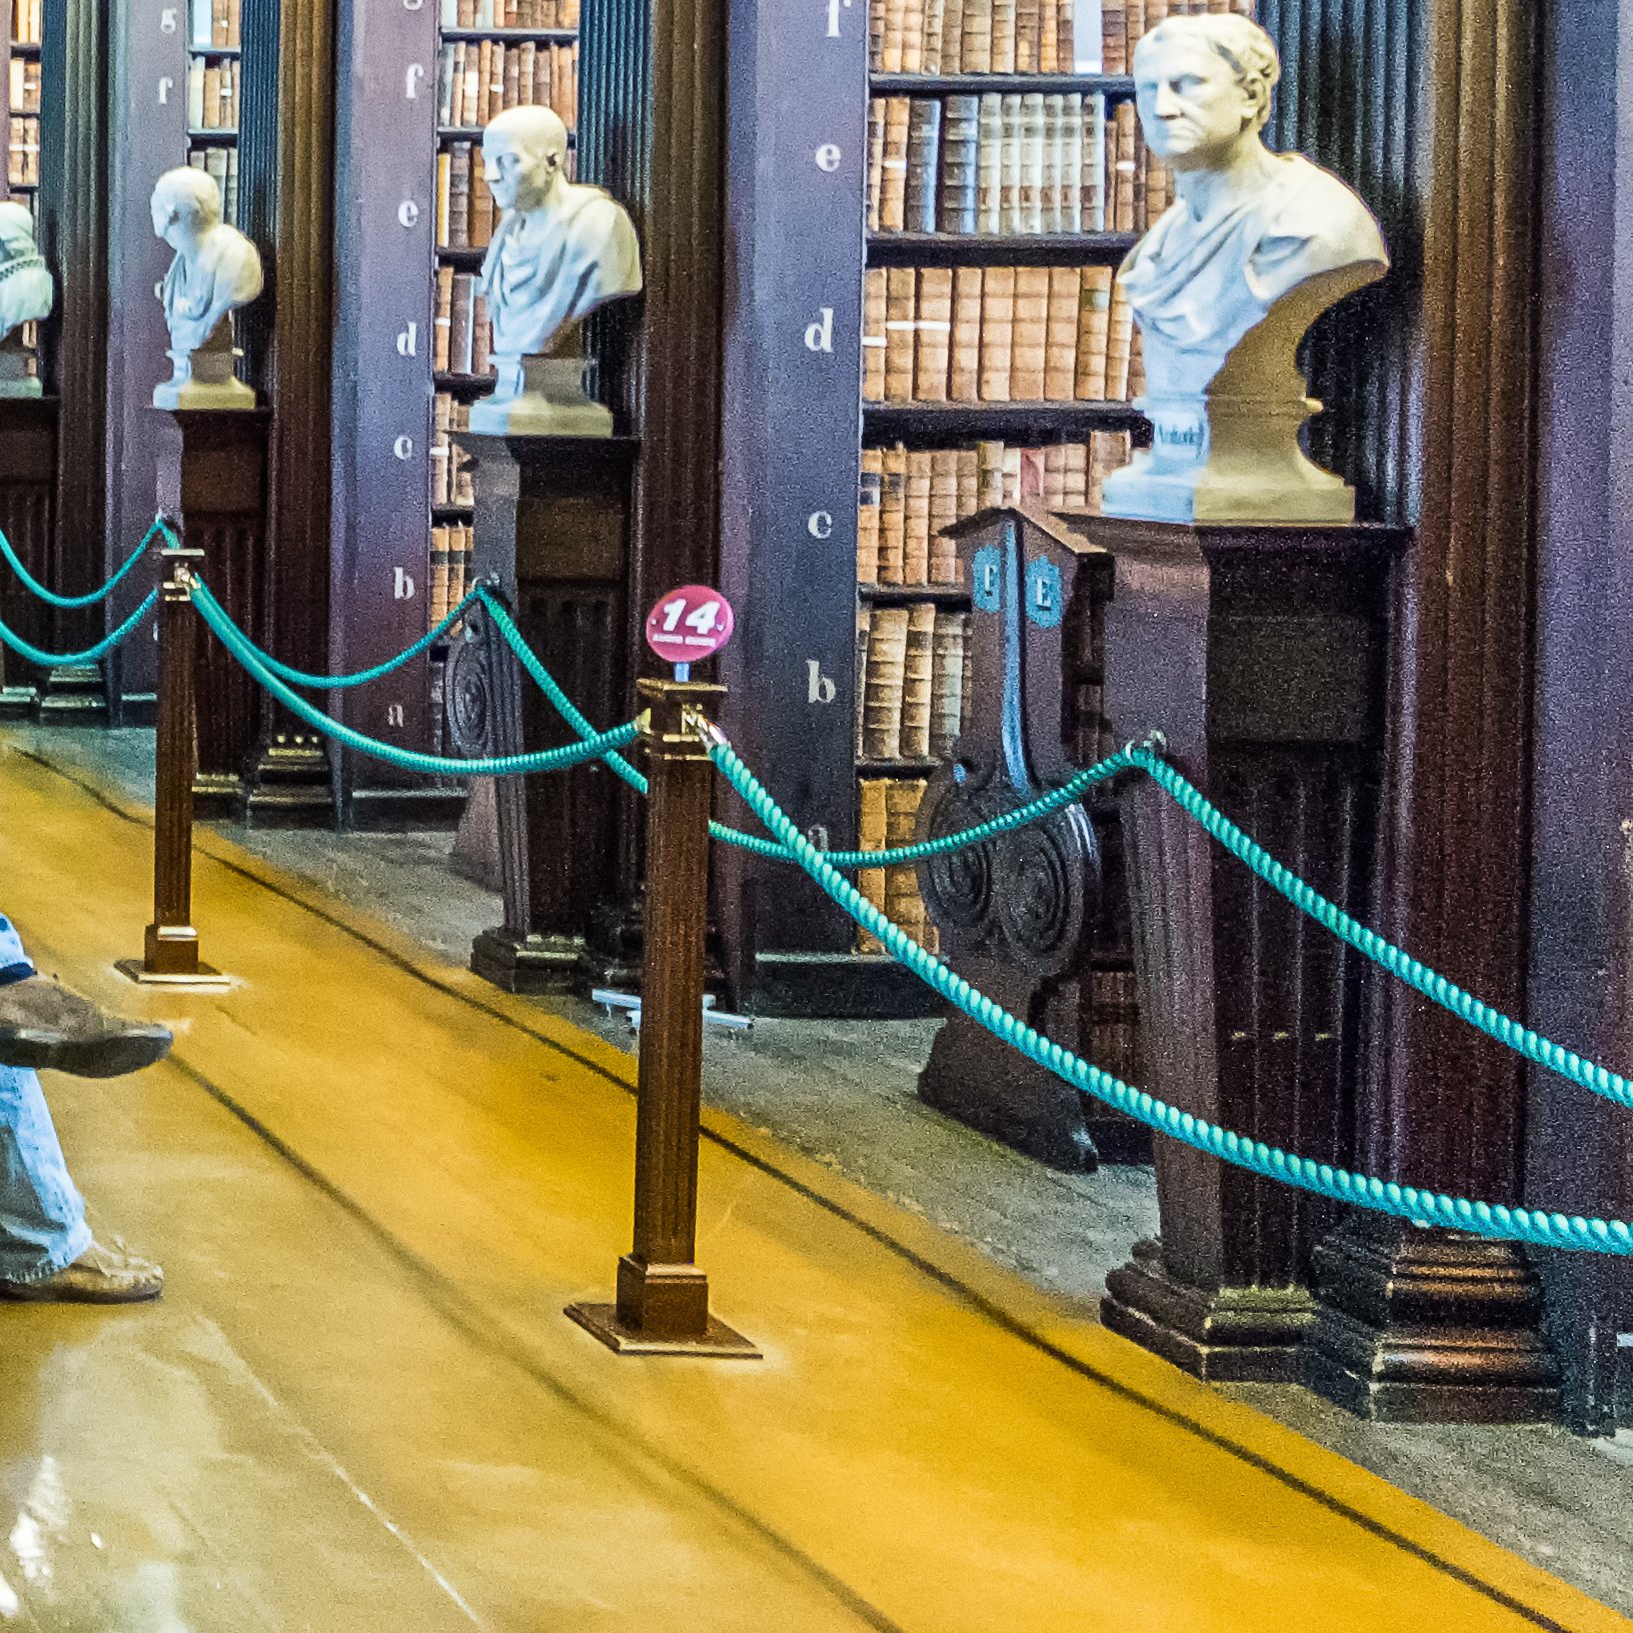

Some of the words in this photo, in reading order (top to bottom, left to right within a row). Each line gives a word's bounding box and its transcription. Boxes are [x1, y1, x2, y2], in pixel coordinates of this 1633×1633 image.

[405, 63, 424, 99] f
[815, 144, 841, 172] e
[398, 200, 419, 227] e
[396, 321, 417, 356] d
[804, 307, 834, 353] d
[393, 435, 413, 460] c
[807, 511, 832, 539] c
[394, 567, 415, 599] b
[662, 598, 721, 635] 14
[806, 659, 836, 703] b
